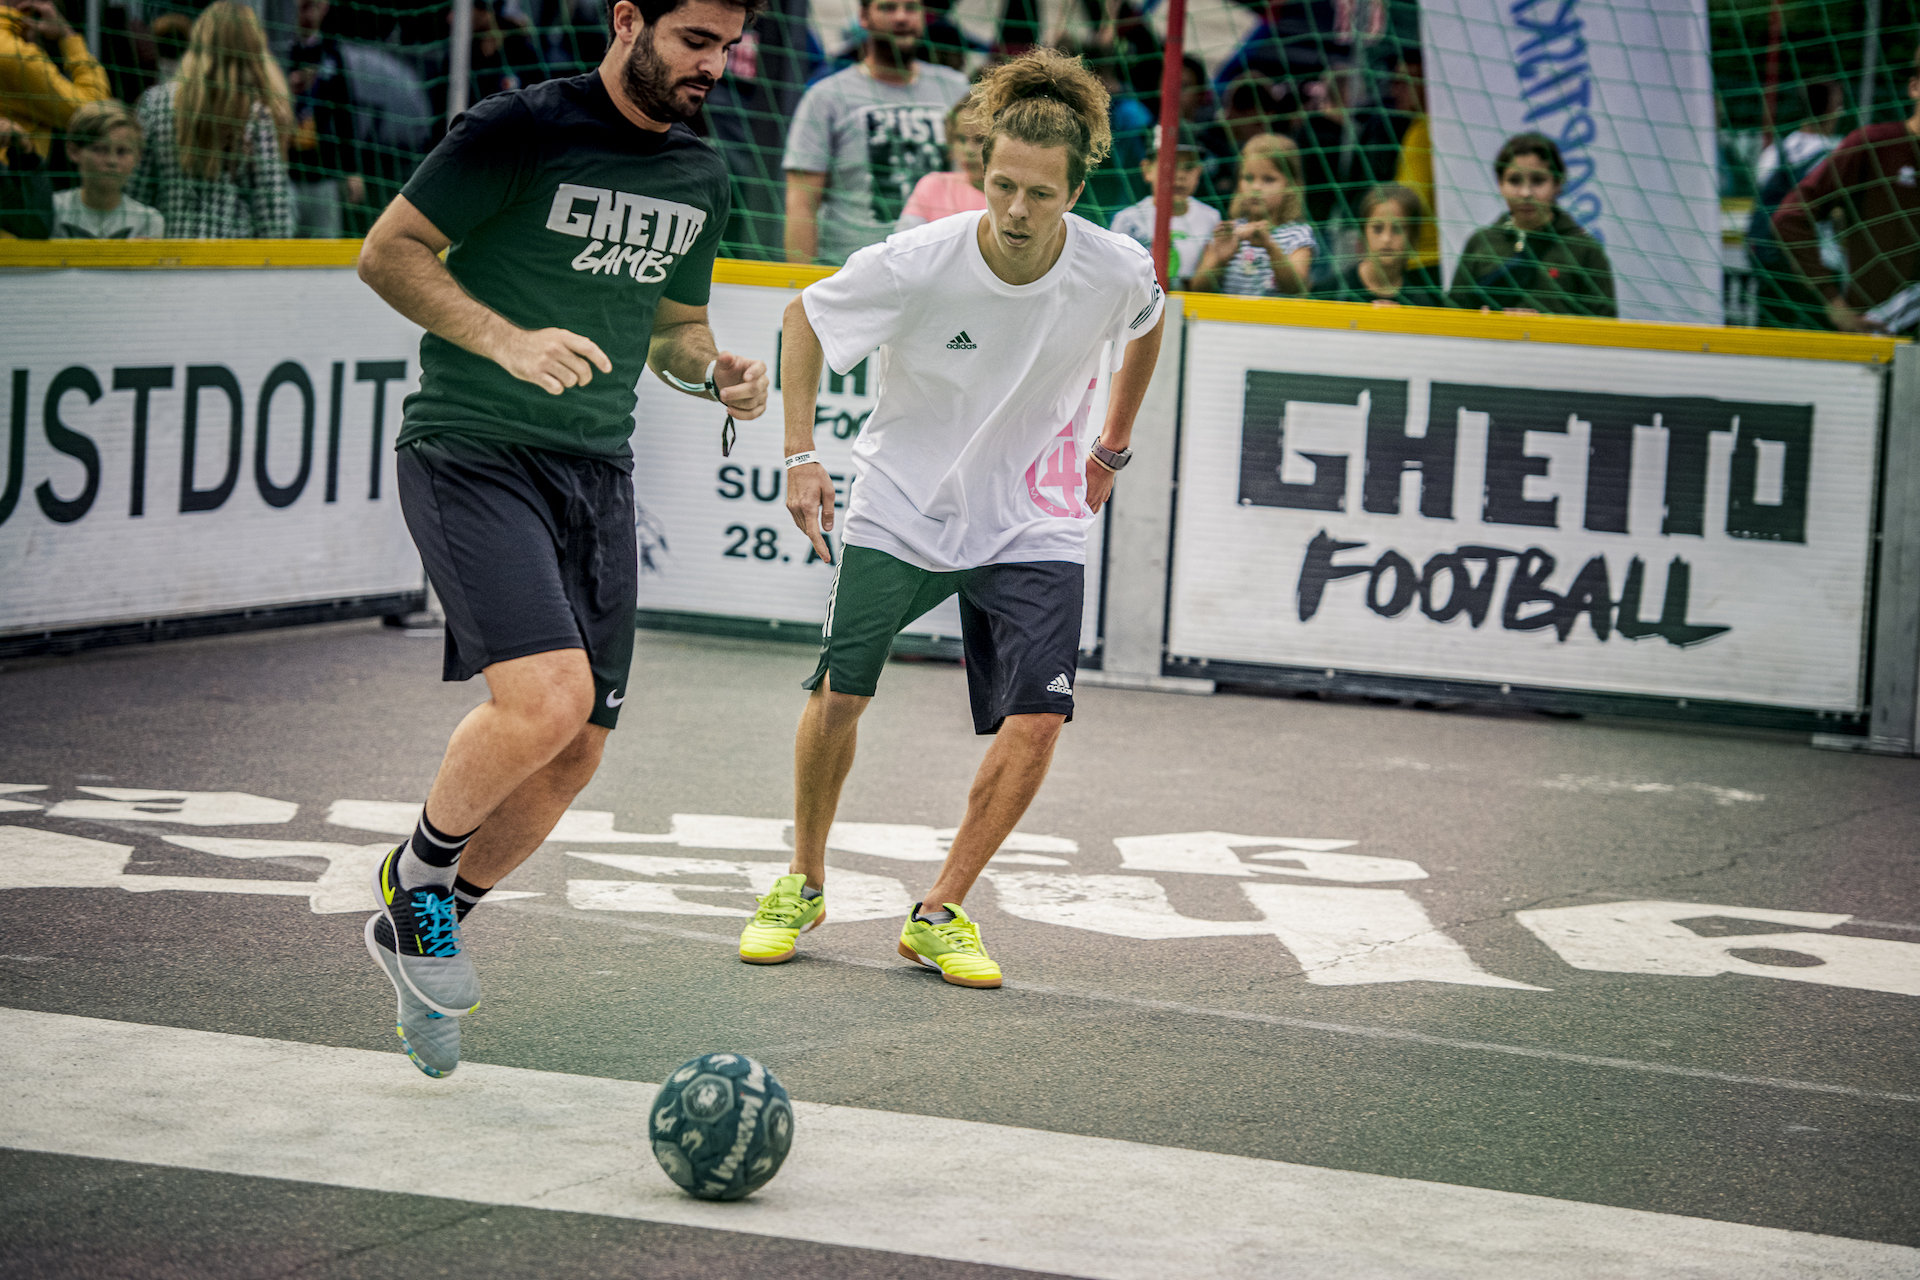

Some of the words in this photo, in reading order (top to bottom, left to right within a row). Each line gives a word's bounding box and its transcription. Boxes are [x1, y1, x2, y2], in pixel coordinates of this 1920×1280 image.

[545, 183, 707, 255] GHETTO
[571, 239, 674, 283] GAMES
[946, 342, 977, 350] adidas
[1238, 369, 1814, 545] GHETTO
[723, 525, 790, 563] 28.
[1298, 529, 1732, 647] FOOTBALL
[1046, 684, 1073, 696] adidas
